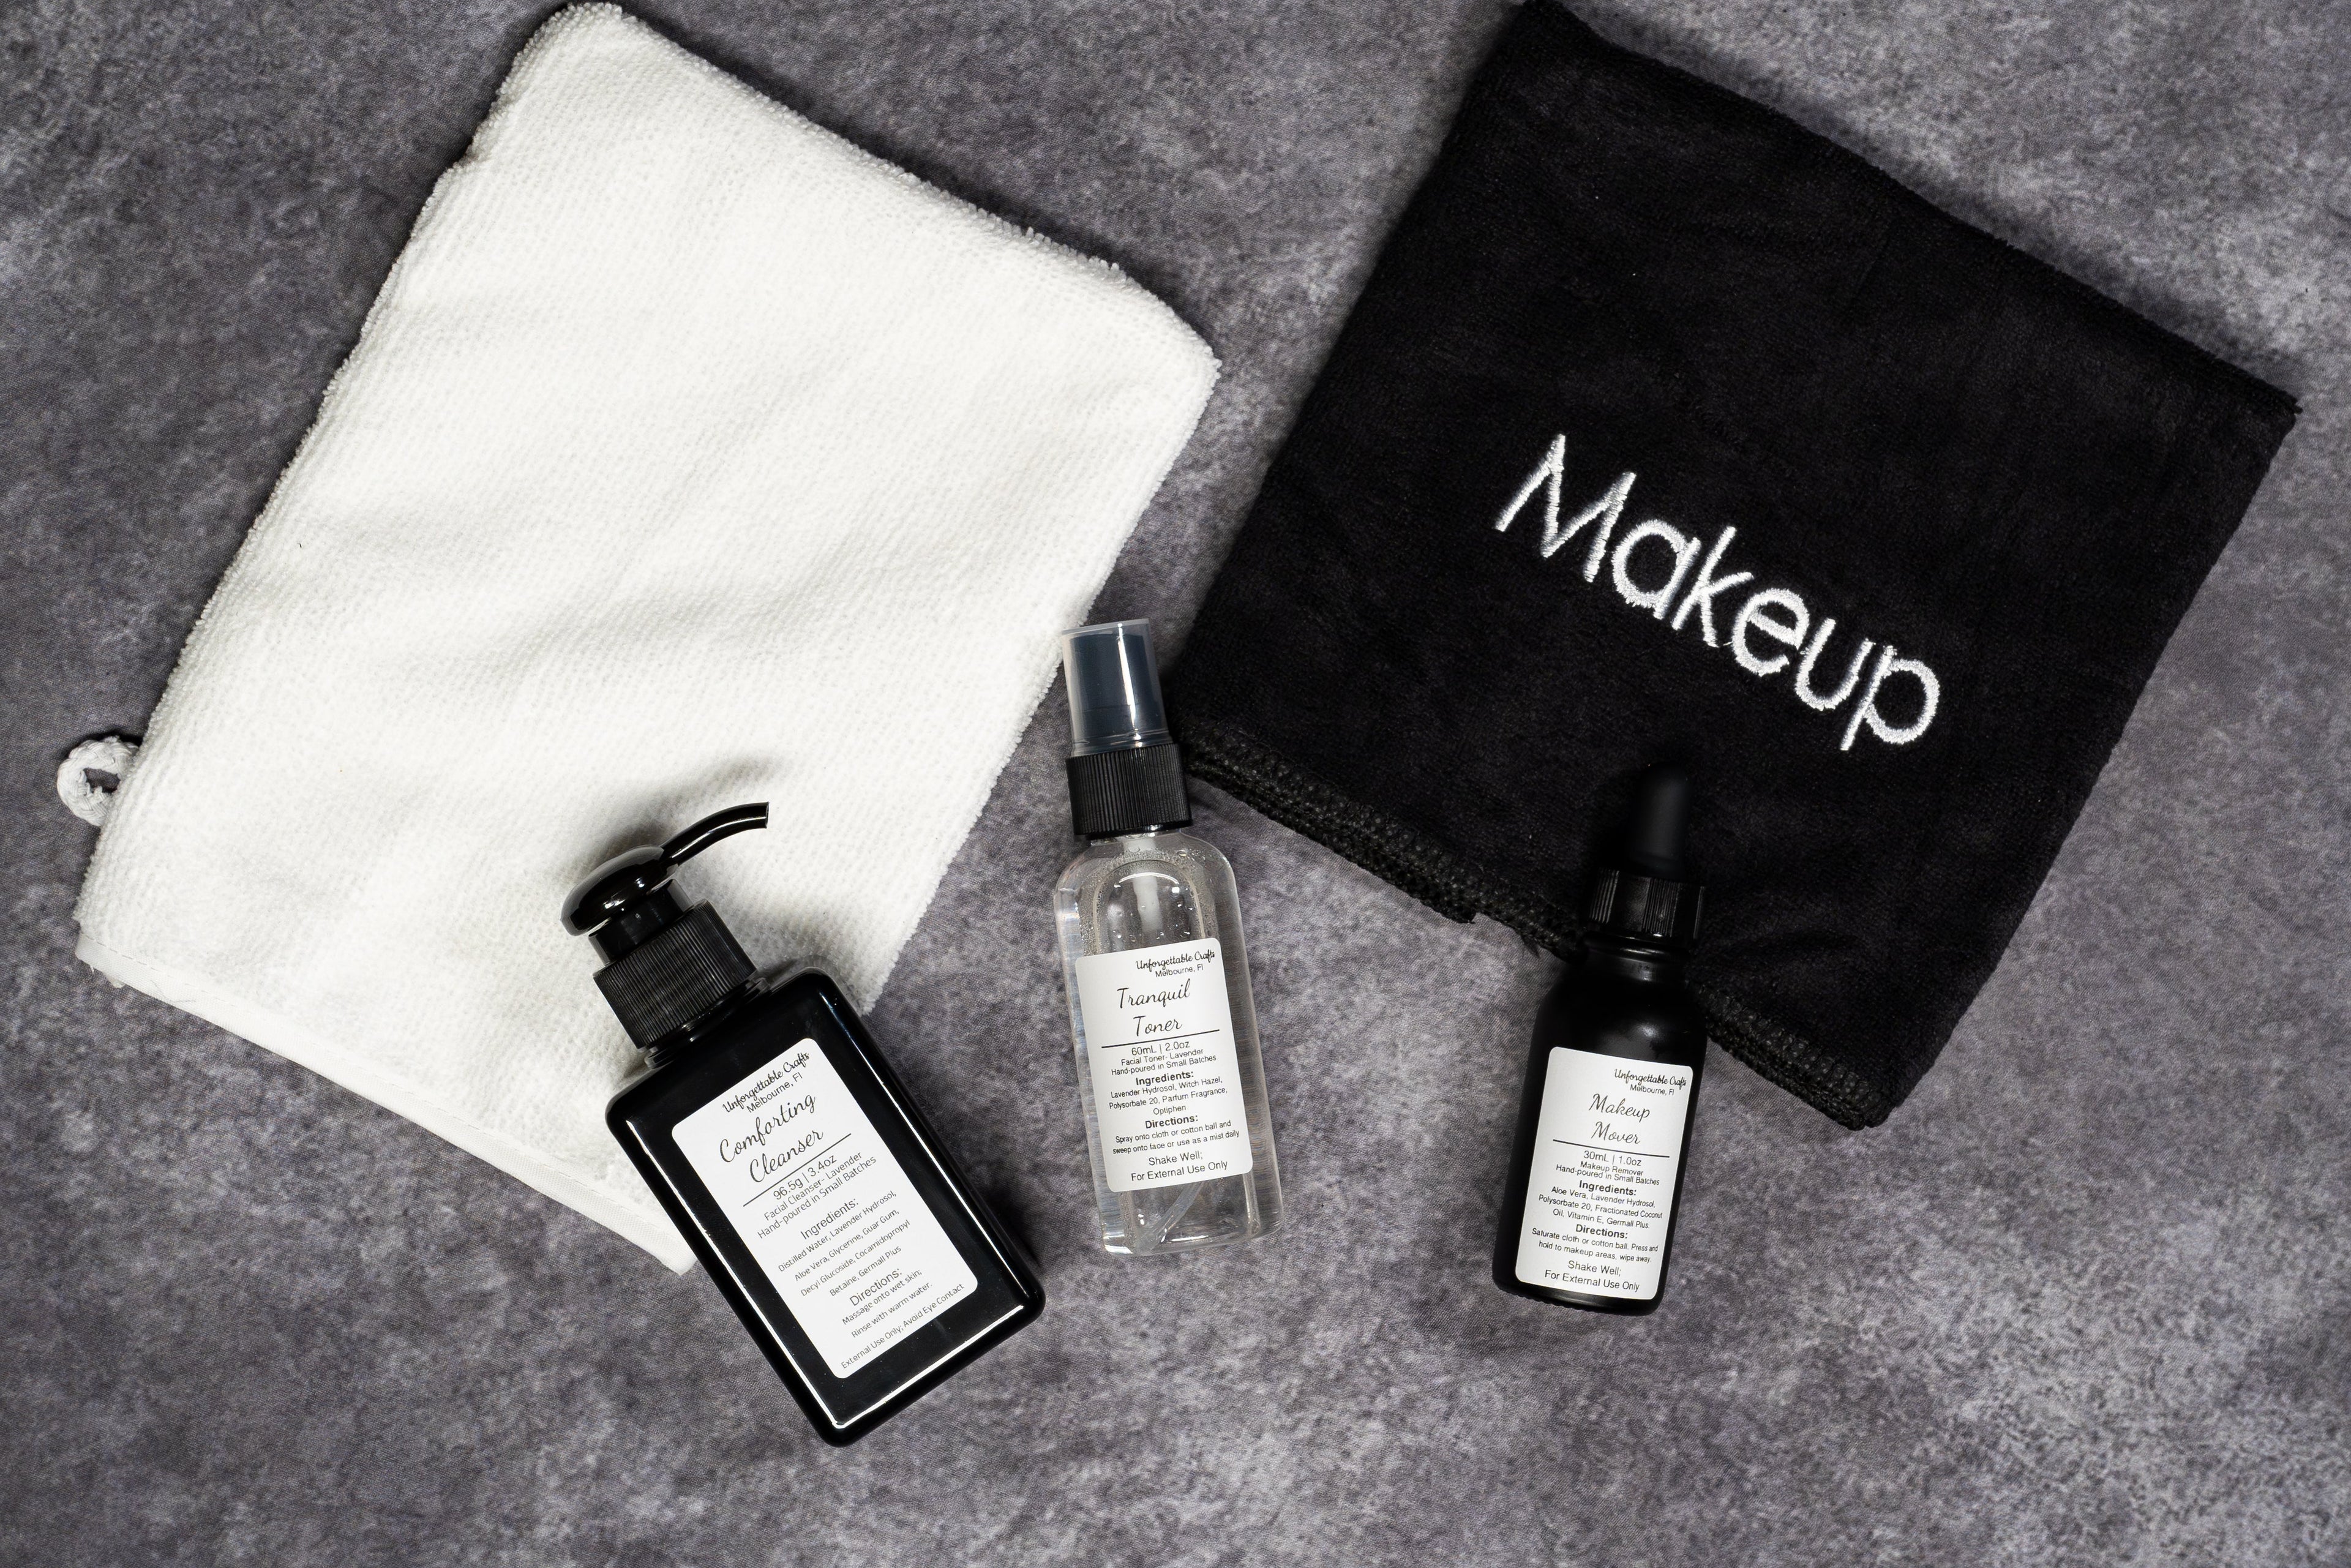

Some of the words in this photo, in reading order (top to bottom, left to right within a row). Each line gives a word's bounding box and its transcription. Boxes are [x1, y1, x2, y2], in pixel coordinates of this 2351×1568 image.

[1494, 433, 1940, 751] Makeup
[1135, 953, 1194, 972] Unforgettable
[1194, 948, 1215, 964] Crafts
[1155, 967, 1196, 978] Melbourne,
[1116, 978, 1191, 1009] Tranquil
[1133, 1015, 1183, 1037] Toner
[1120, 1057, 1142, 1066] Facial
[1169, 1048, 1203, 1059] Lavender
[1131, 1045, 1157, 1056] 60mL
[1164, 1041, 1191, 1051] 2.0oz
[1111, 1063, 1156, 1076] Hand-poured
[1166, 1059, 1187, 1068] Small
[1188, 1055, 1217, 1065] Batches
[722, 1070, 784, 1113] Unforgettable
[782, 1052, 810, 1073] Crafts
[1111, 1089, 1141, 1098] Lavender
[1142, 1083, 1177, 1095] Hydrosol,
[1178, 1079, 1199, 1089] Witch
[1201, 1076, 1223, 1086] Hazel,
[1135, 1071, 1194, 1087] Ingredients:
[1614, 1068, 1669, 1086] Unforgettable
[1669, 1076, 1687, 1091] Crafts
[1630, 1083, 1667, 1096] Melbourne,
[746, 1081, 794, 1113] Melbourne,
[1109, 1099, 1147, 1111] Polysorbate
[1149, 1097, 1160, 1105] 20,
[1162, 1093, 1189, 1103] Parfum
[1190, 1087, 1228, 1098] Fragrance,
[1588, 1093, 1651, 1123] Makeup
[1145, 1115, 1199, 1129] Directions:
[1153, 1105, 1187, 1116] Optiphen
[719, 1094, 816, 1163] Comforting
[1115, 1136, 1133, 1144] Spray
[1152, 1130, 1169, 1139] cloth
[1180, 1126, 1204, 1135] cotton
[1204, 1122, 1218, 1131] ball
[1219, 1119, 1232, 1128] and
[1209, 1133, 1224, 1141] mist
[1224, 1130, 1240, 1138] daily
[1591, 1121, 1641, 1144] Mover
[749, 1130, 823, 1183] Cleanser
[1148, 1155, 1177, 1166] Shake
[1179, 1150, 1203, 1161] Well;
[1580, 1160, 1610, 1172] Makeup
[1611, 1165, 1644, 1176] Remover
[1583, 1150, 1609, 1162] 30mL
[1619, 1155, 1642, 1167] 1.0oz
[773, 1178, 804, 1200] 96.5g
[808, 1155, 838, 1177] 3.4oz
[1131, 1172, 1146, 1182] For
[1147, 1166, 1185, 1180] External
[1187, 1165, 1205, 1174] Use
[1207, 1160, 1228, 1171] Only
[1556, 1163, 1603, 1179] Hand-poured
[1613, 1173, 1634, 1183] Small
[1635, 1176, 1660, 1186] Batches
[757, 1198, 812, 1239] Hand-poured
[810, 1195, 820, 1204] in
[819, 1177, 844, 1198] Small
[842, 1157, 877, 1182] Batches
[763, 1201, 789, 1221] Facial
[787, 1178, 825, 1205] Cleanser-
[825, 1152, 862, 1180] Lavender
[1551, 1186, 1567, 1196] Aloe
[1569, 1188, 1588, 1200] Vera,
[1591, 1193, 1625, 1204] Lavender
[1626, 1198, 1655, 1209] Hydrosol,
[1578, 1179, 1637, 1196] Ingredients:
[1538, 1194, 1580, 1209] Polysorbate
[1581, 1202, 1592, 1212] 20,
[1595, 1204, 1640, 1217] Fractionated
[1640, 1210, 1663, 1219] Coconut
[1553, 1208, 1564, 1218] Oil,
[1567, 1210, 1595, 1222] Vitamin
[1596, 1215, 1604, 1225] E,
[1607, 1217, 1634, 1227] Germall
[1635, 1220, 1650, 1229] Plus.
[778, 1249, 808, 1272] Distilled
[806, 1235, 831, 1253] Water,
[829, 1212, 863, 1237] Lavender
[862, 1190, 897, 1215] Hydrosol,
[800, 1198, 859, 1240] Ingredients:
[1575, 1223, 1628, 1239] Directions:
[795, 1268, 811, 1281] Aloe
[809, 1256, 830, 1270] Vera,
[828, 1234, 864, 1258] Glycerine,
[862, 1221, 879, 1236] Guar
[879, 1210, 899, 1224] Gum,
[1531, 1227, 1560, 1240] Saturate
[1562, 1234, 1580, 1243] cloth
[1591, 1240, 1614, 1248] cotton
[1630, 1243, 1648, 1252] Press
[1539, 1240, 1553, 1250] hold
[1564, 1247, 1594, 1258] makeup
[1595, 1251, 1617, 1260] areas,
[1619, 1253, 1635, 1262] wipe
[800, 1279, 821, 1297] Decyl
[820, 1259, 857, 1283] Glucoside,
[855, 1219, 910, 1259] Cocamidopropyl
[1567, 1260, 1597, 1273] Shake
[1600, 1265, 1621, 1277] Well;
[829, 1276, 860, 1297] Betaine,
[858, 1255, 886, 1277] Germall
[884, 1246, 902, 1259] Plus
[1544, 1269, 1561, 1280] For
[1562, 1272, 1601, 1286] External
[1603, 1278, 1620, 1289] Use
[1622, 1281, 1640, 1293] Only
[842, 1302, 873, 1326] Massage
[873, 1291, 890, 1304] onto
[890, 1280, 906, 1293] wet
[904, 1269, 922, 1283] skin;
[849, 1268, 902, 1307] Directions:
[851, 1322, 872, 1338] Rinse
[871, 1311, 888, 1324] with
[888, 1297, 909, 1313] warm
[909, 1282, 932, 1299] water.
[841, 1345, 872, 1369] External
[870, 1337, 885, 1349] Use
[884, 1325, 904, 1340] Only;
[903, 1310, 923, 1328] Avoid
[922, 1302, 937, 1314] Eye
[936, 1283, 965, 1305] Contact
